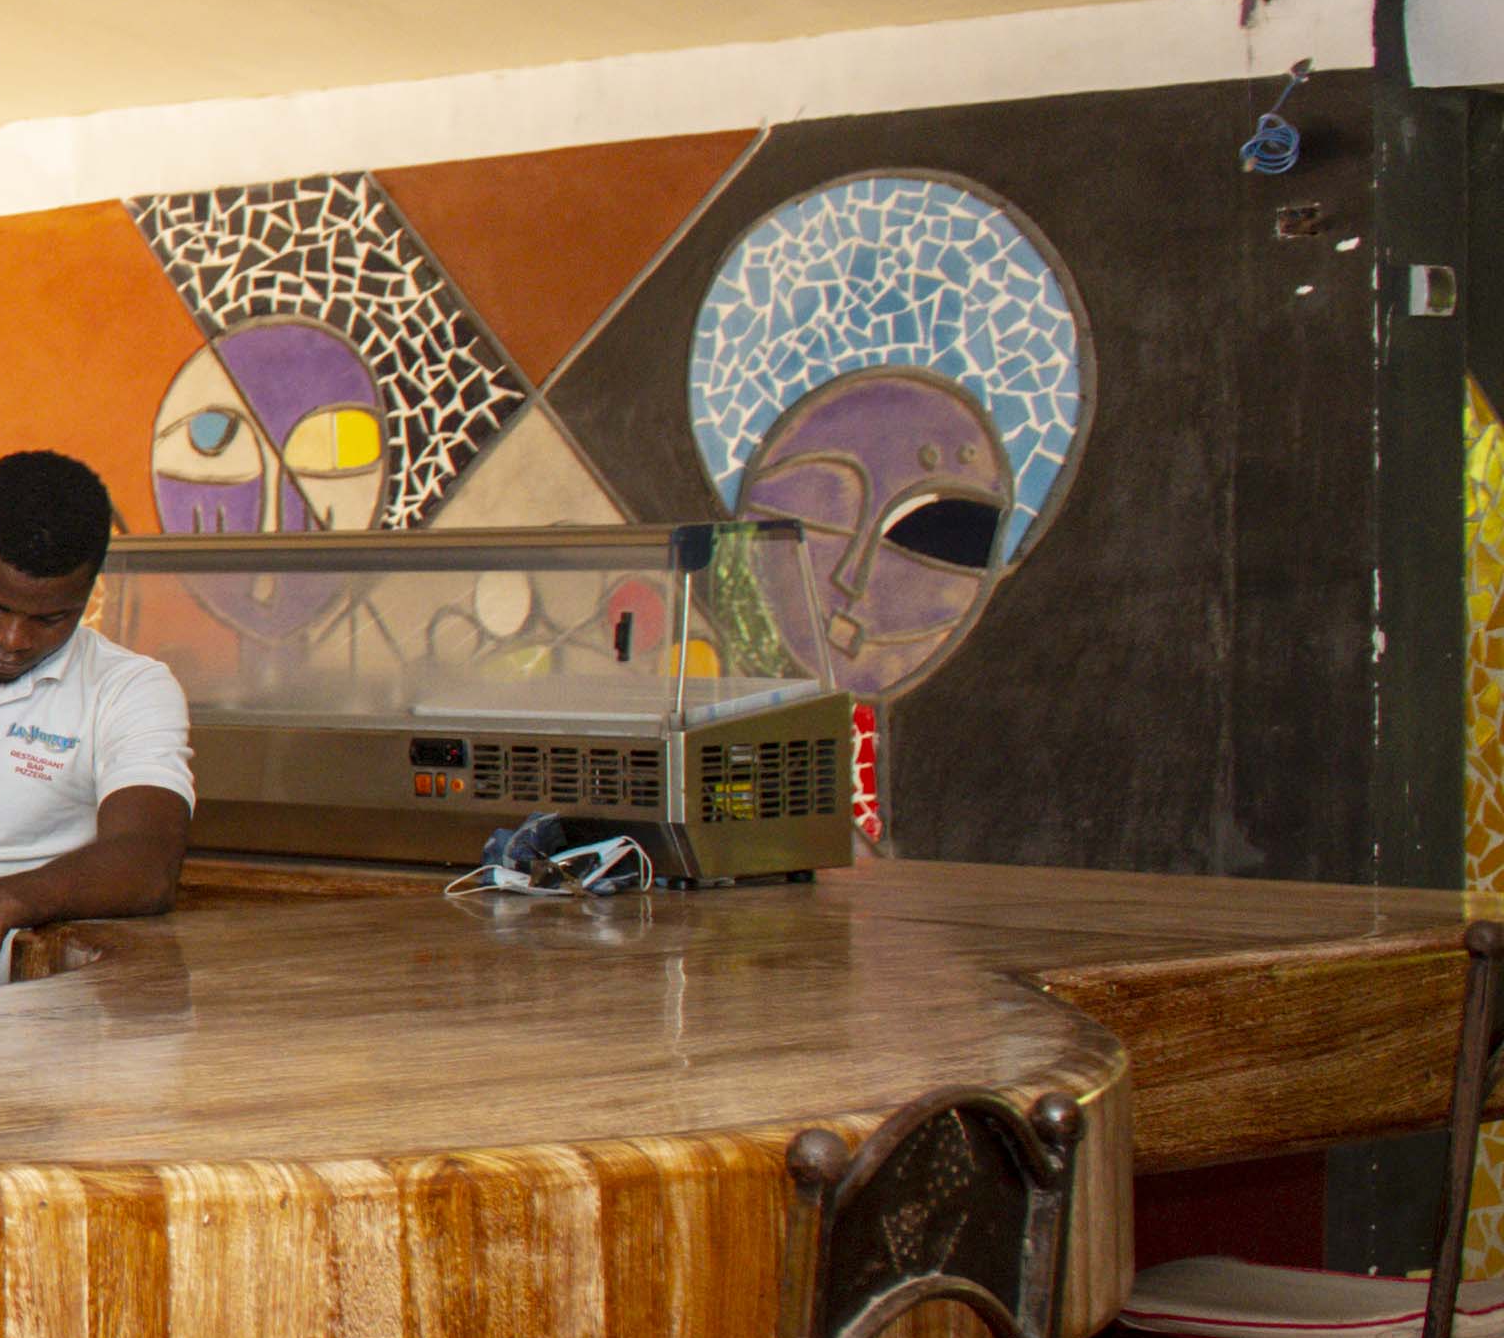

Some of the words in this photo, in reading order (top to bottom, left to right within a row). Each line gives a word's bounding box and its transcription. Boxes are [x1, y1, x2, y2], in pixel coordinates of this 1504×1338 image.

[10, 749, 65, 770] RESTAURANT
[26, 762, 45, 772] BAR
[15, 766, 53, 781] PIZZERIA
